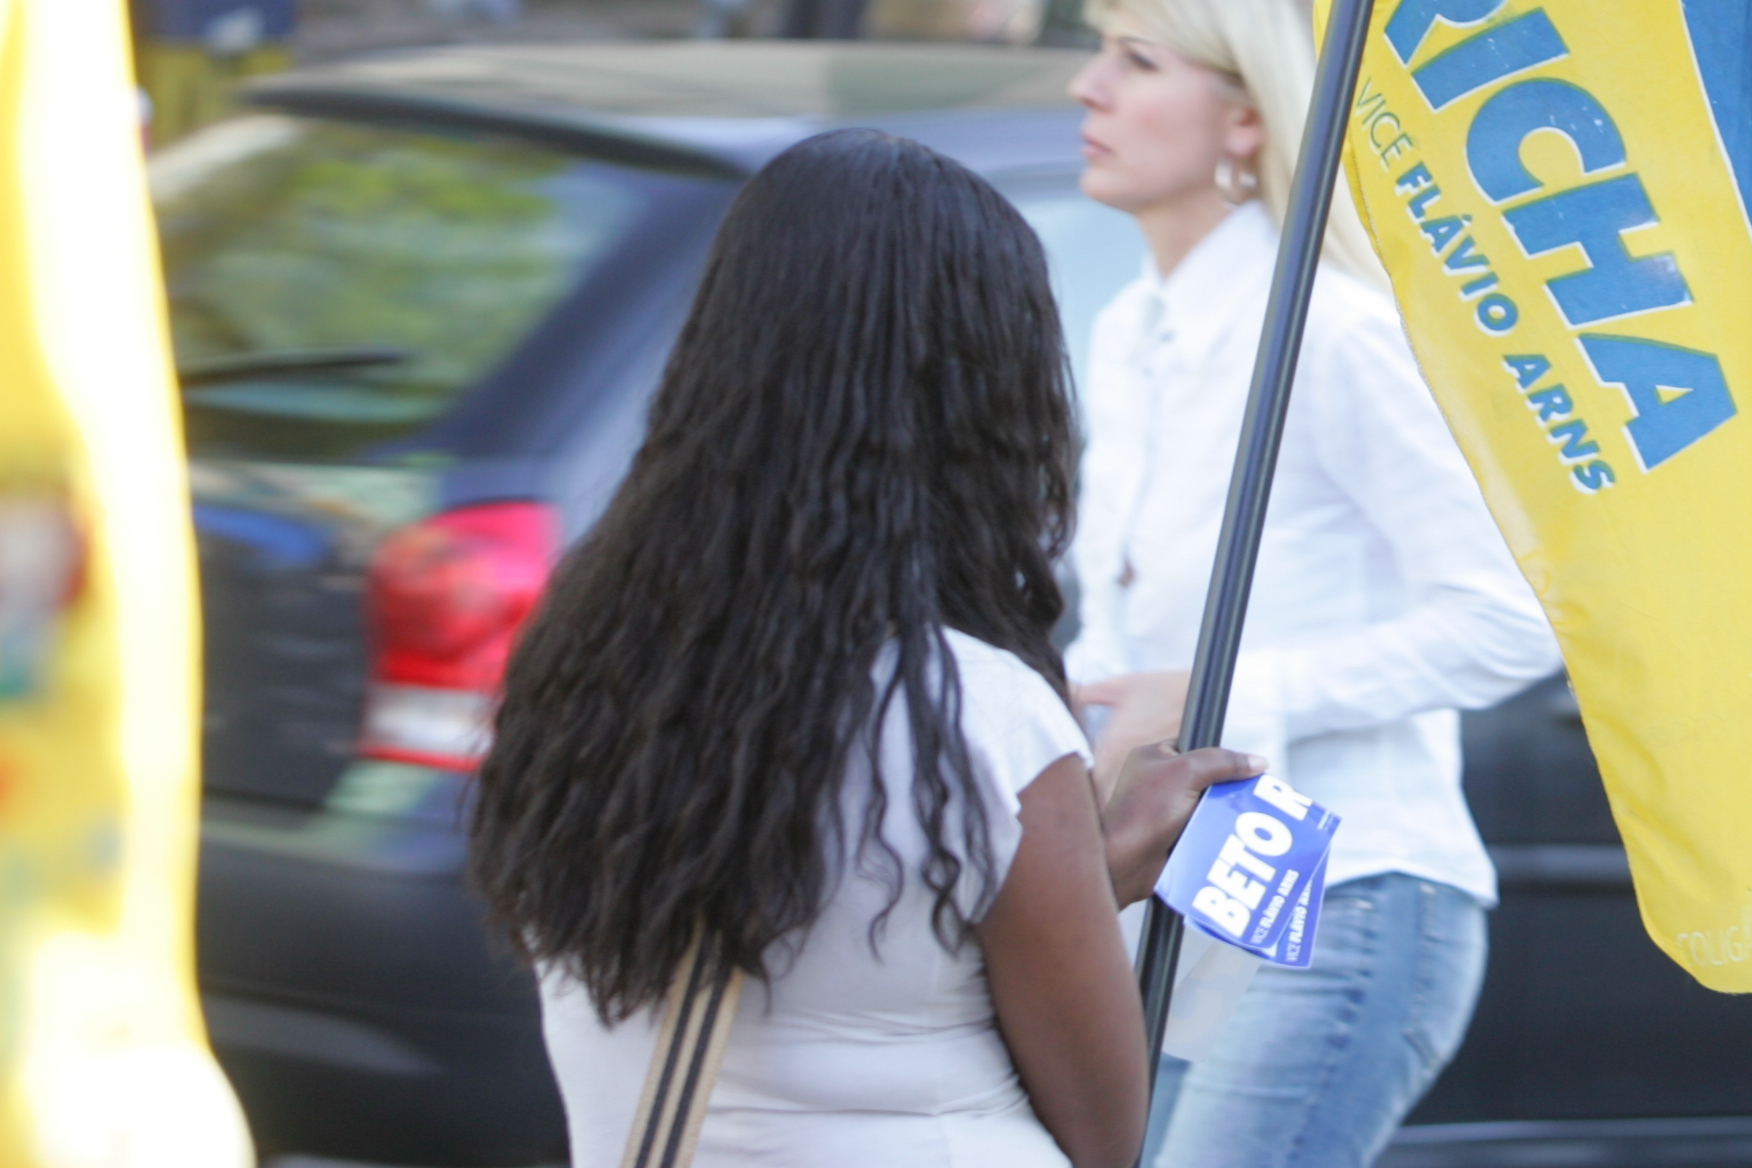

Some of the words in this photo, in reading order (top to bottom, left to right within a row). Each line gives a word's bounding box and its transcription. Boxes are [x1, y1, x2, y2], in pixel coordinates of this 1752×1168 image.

[1355, 76, 1413, 173] VICE
[1394, 160, 1519, 338] FLÁVIO
[1501, 353, 1617, 496] ARNS
[1191, 810, 1294, 939] BETO
